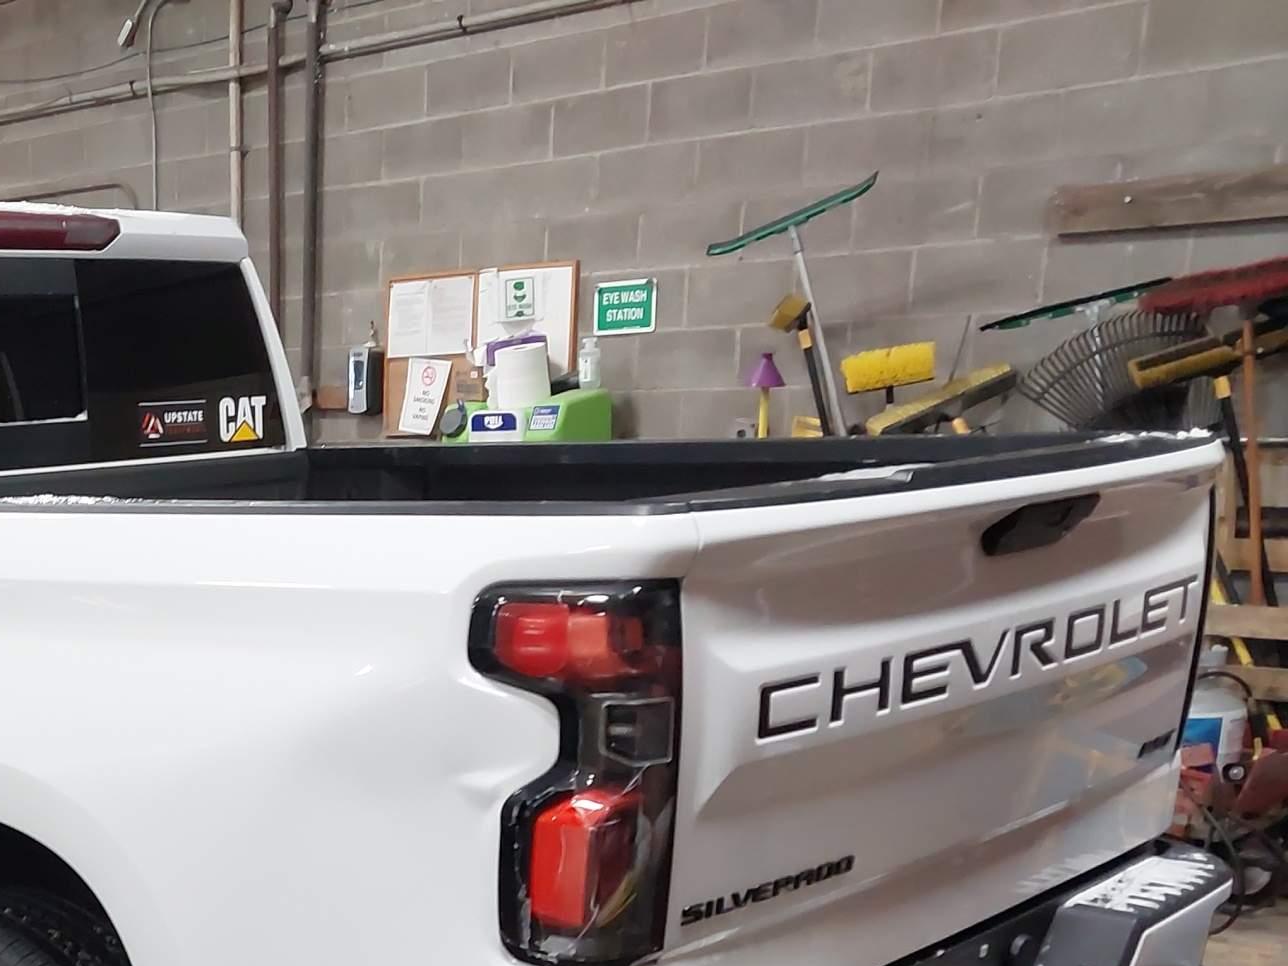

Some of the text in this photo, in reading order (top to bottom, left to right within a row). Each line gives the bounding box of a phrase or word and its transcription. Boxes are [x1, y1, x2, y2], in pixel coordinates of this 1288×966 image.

[602, 289, 648, 305] EYE WASH
[605, 307, 644, 322] STATION
[163, 410, 204, 424] UPSTATE
[219, 395, 267, 443] CAT
[755, 574, 1199, 743] CHEVROLET
[680, 854, 855, 927] SILVERADO
